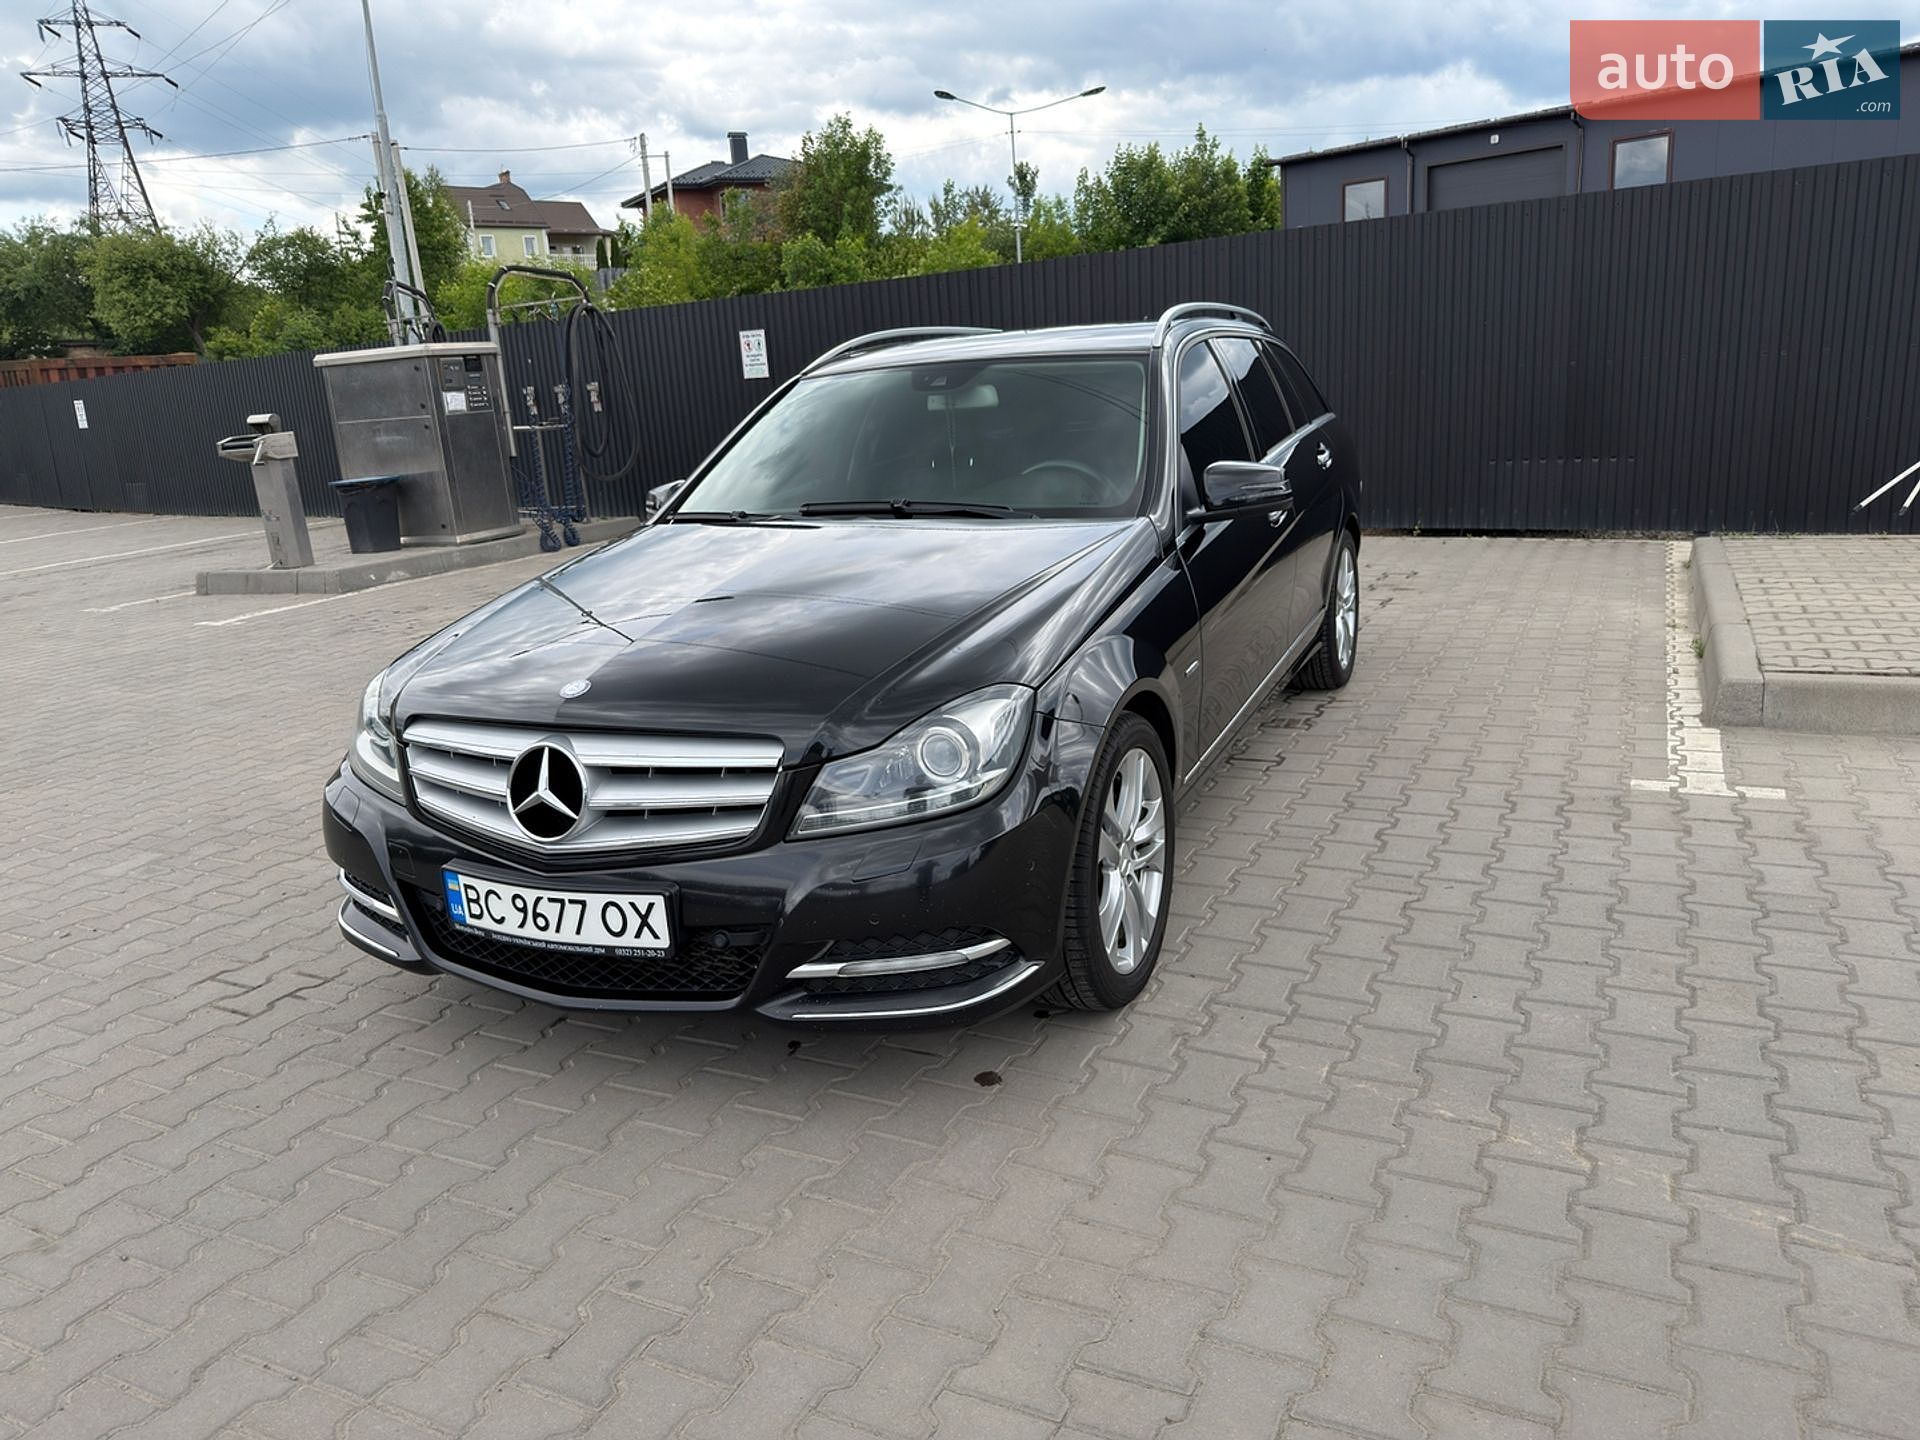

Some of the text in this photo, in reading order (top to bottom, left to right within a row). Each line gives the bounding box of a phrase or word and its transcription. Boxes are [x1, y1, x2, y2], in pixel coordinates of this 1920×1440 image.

[450, 902, 464, 916] UA
[463, 883, 661, 940] BC 9677 OX
